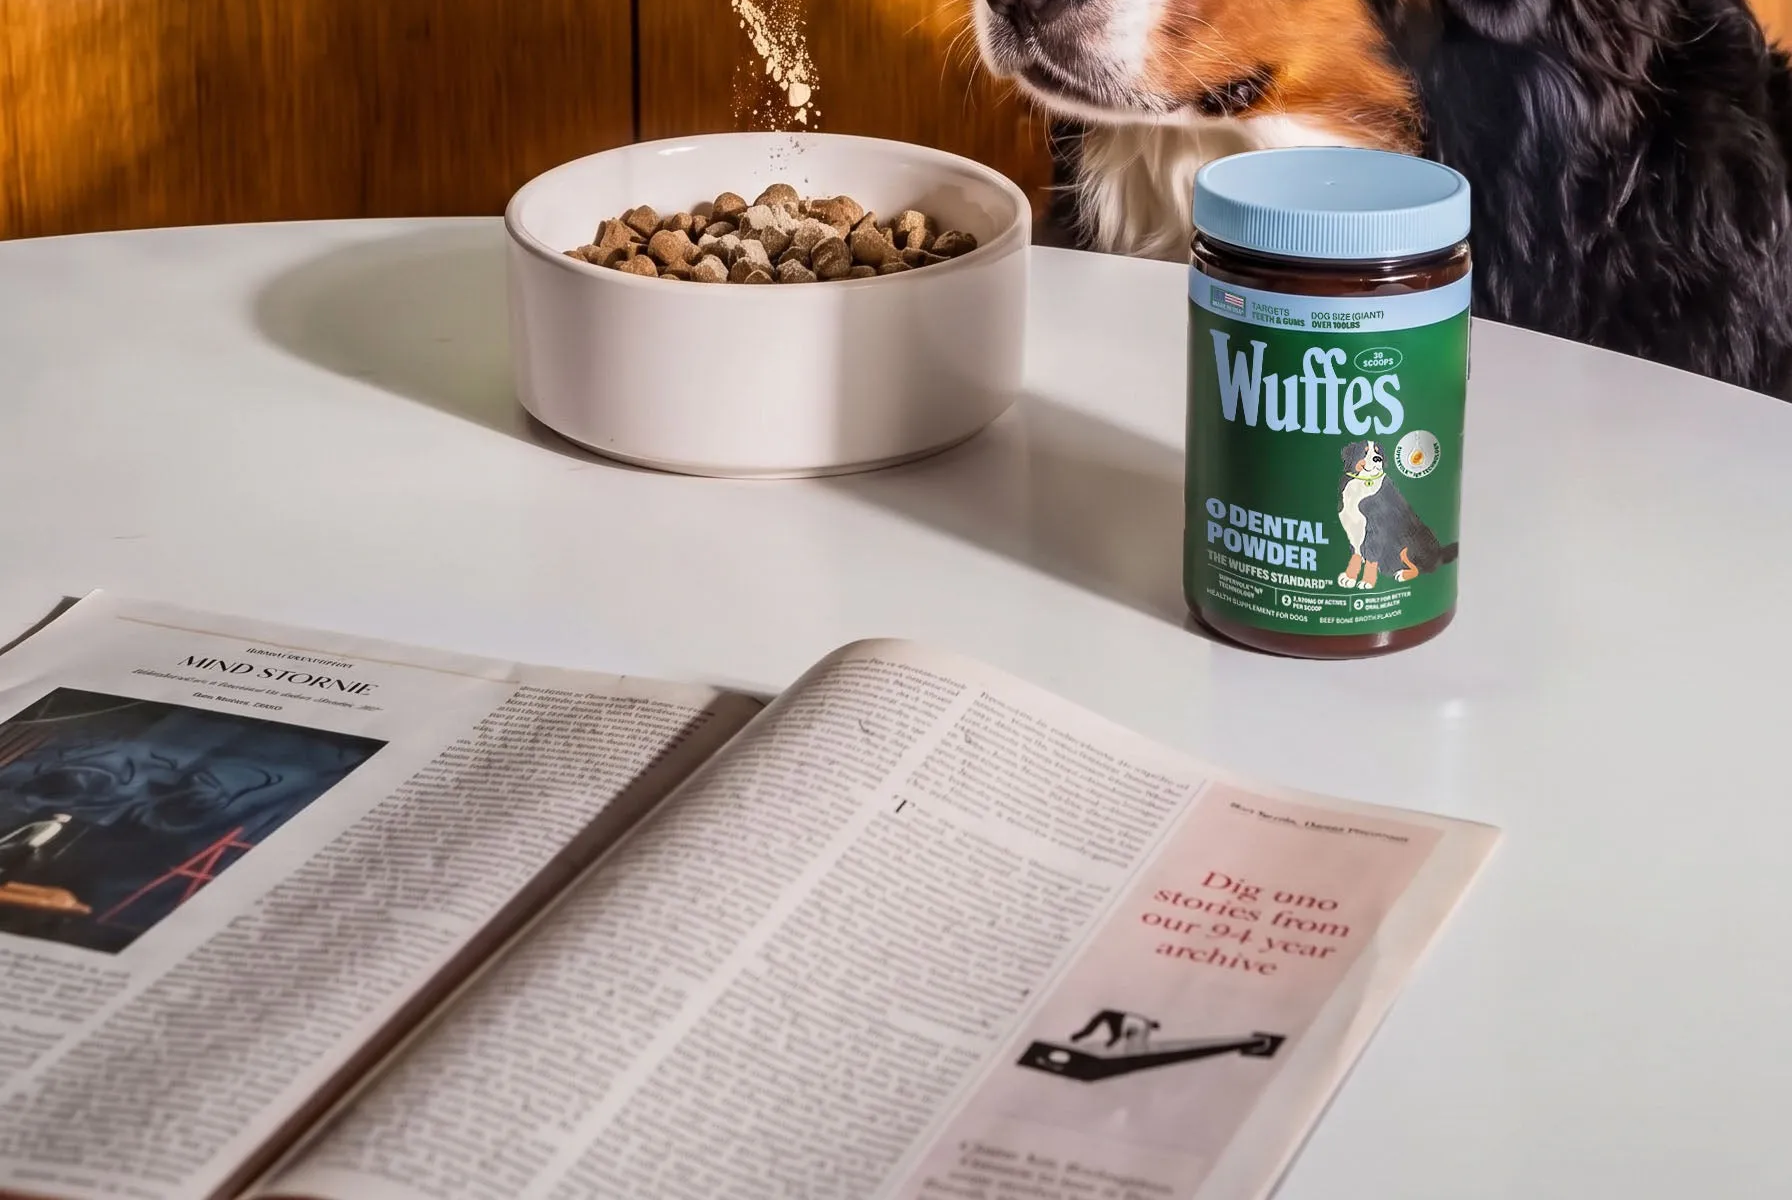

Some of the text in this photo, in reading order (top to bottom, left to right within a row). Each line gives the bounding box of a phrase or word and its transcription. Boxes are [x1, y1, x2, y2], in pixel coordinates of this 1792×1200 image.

[1252, 302, 1290, 316] TARGETS
[1276, 316, 1282, 325] &
[1283, 317, 1305, 327] GUMS
[1311, 310, 1384, 322] DOG SIZE (GIANT)
[1312, 320, 1360, 329] OVER 100LBS
[1362, 358, 1394, 368] SCOOPS
[1210, 328, 1404, 436] Wuffes
[1230, 503, 1329, 544] DENTAL
[1208, 520, 1316, 572] POWDER
[1207, 550, 1227, 566] THE
[1228, 560, 1270, 580] WUFFES
[1206, 587, 1308, 622] HEALTH SUPPLEMENT FOR DOGS
[1354, 614, 1376, 623] BROTH
[1377, 610, 1402, 620] FLAVOR
[178, 655, 255, 675] MIND
[1201, 871, 1264, 902] Dig
[1154, 888, 1350, 938] stories from
[1141, 912, 1337, 960] our 94 year
[1155, 941, 1277, 976] archive
